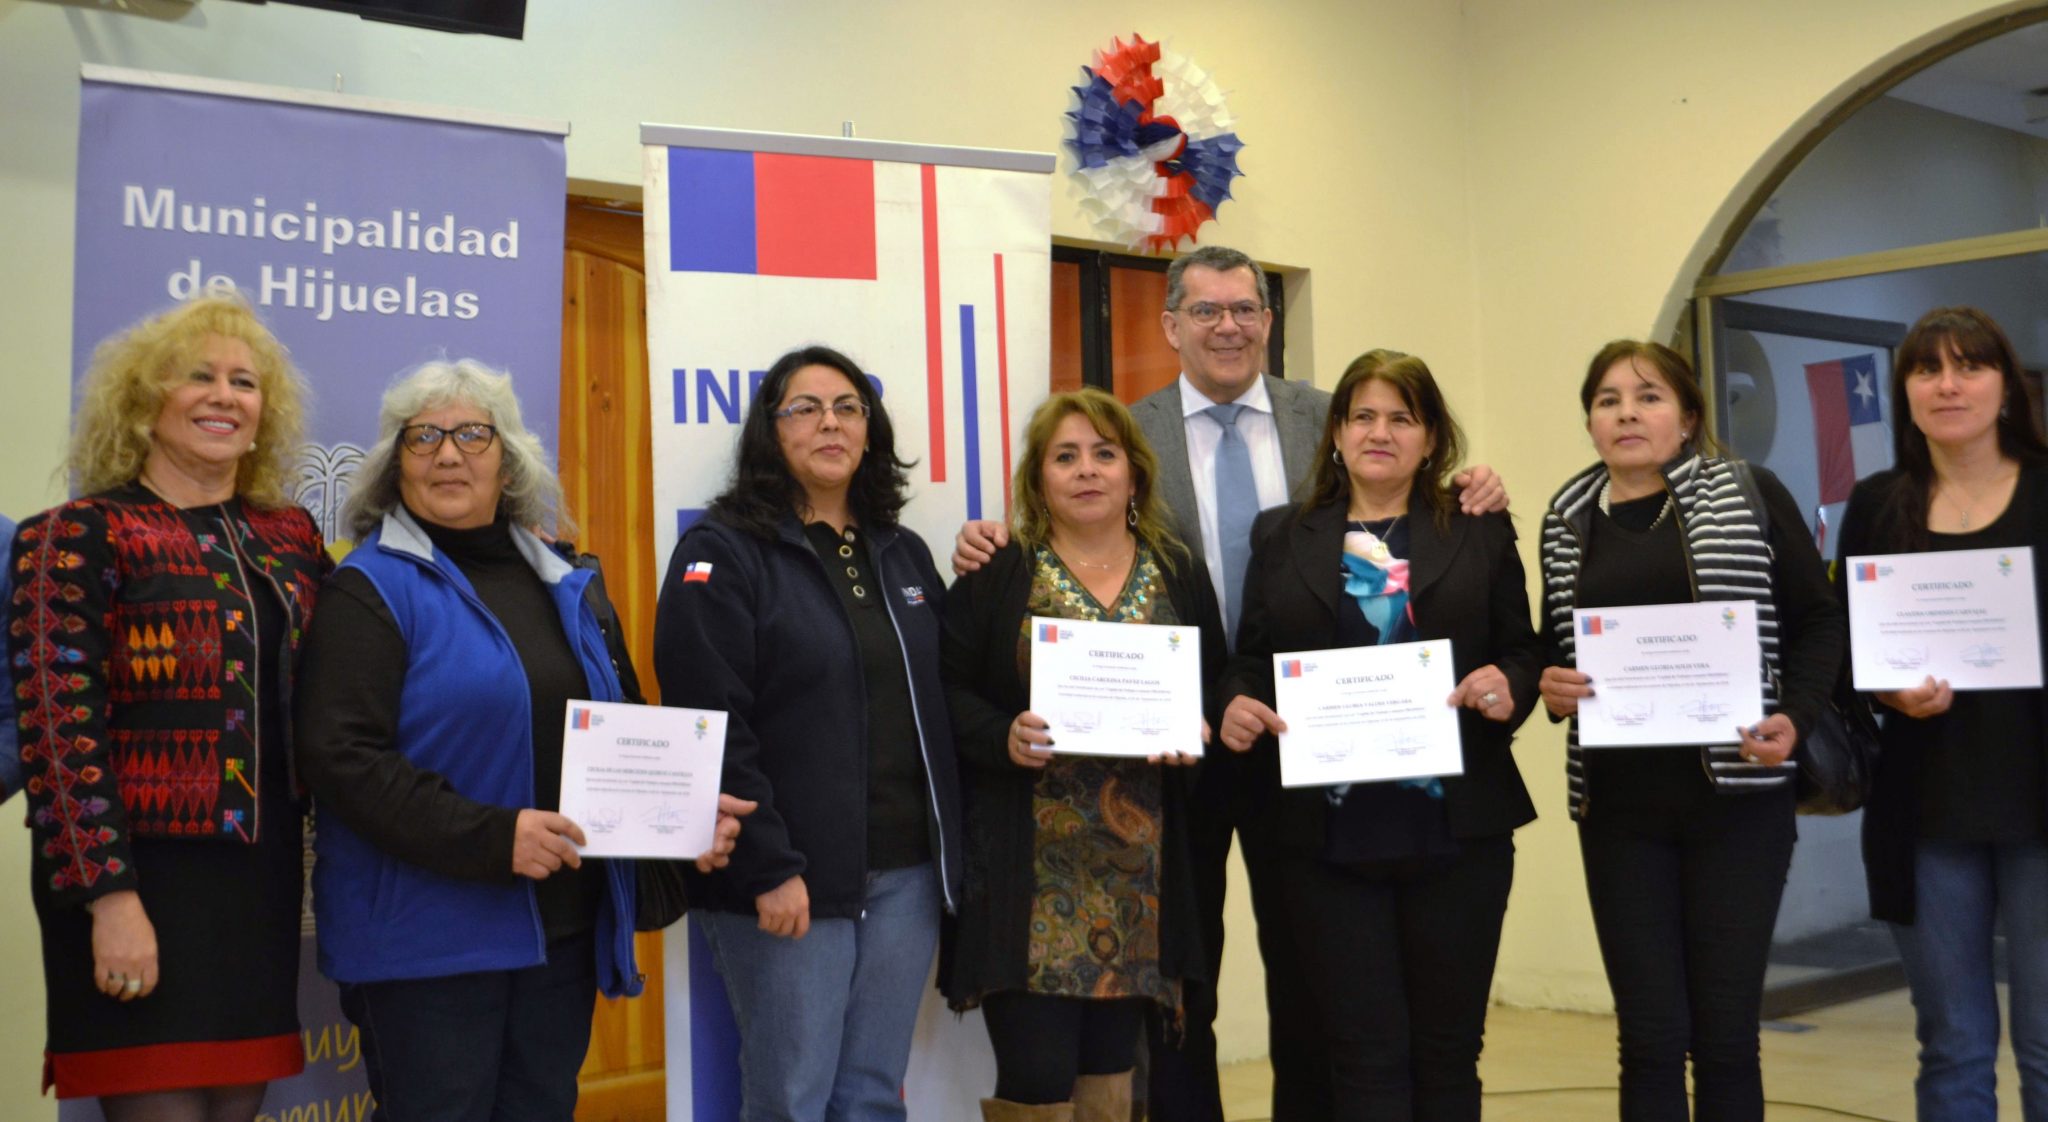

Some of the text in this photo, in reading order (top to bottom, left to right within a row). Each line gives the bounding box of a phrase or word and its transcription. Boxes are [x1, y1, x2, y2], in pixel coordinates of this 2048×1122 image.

[123, 184, 519, 259] Municipalidad
[168, 260, 480, 321] de Hijuelas
[1636, 634, 1697, 645] CERTIFICADO
[1089, 649, 1145, 660] CERTIFICADO
[1335, 673, 1395, 685] CERTIFICADO
[616, 737, 670, 749] CERTIFICADO
